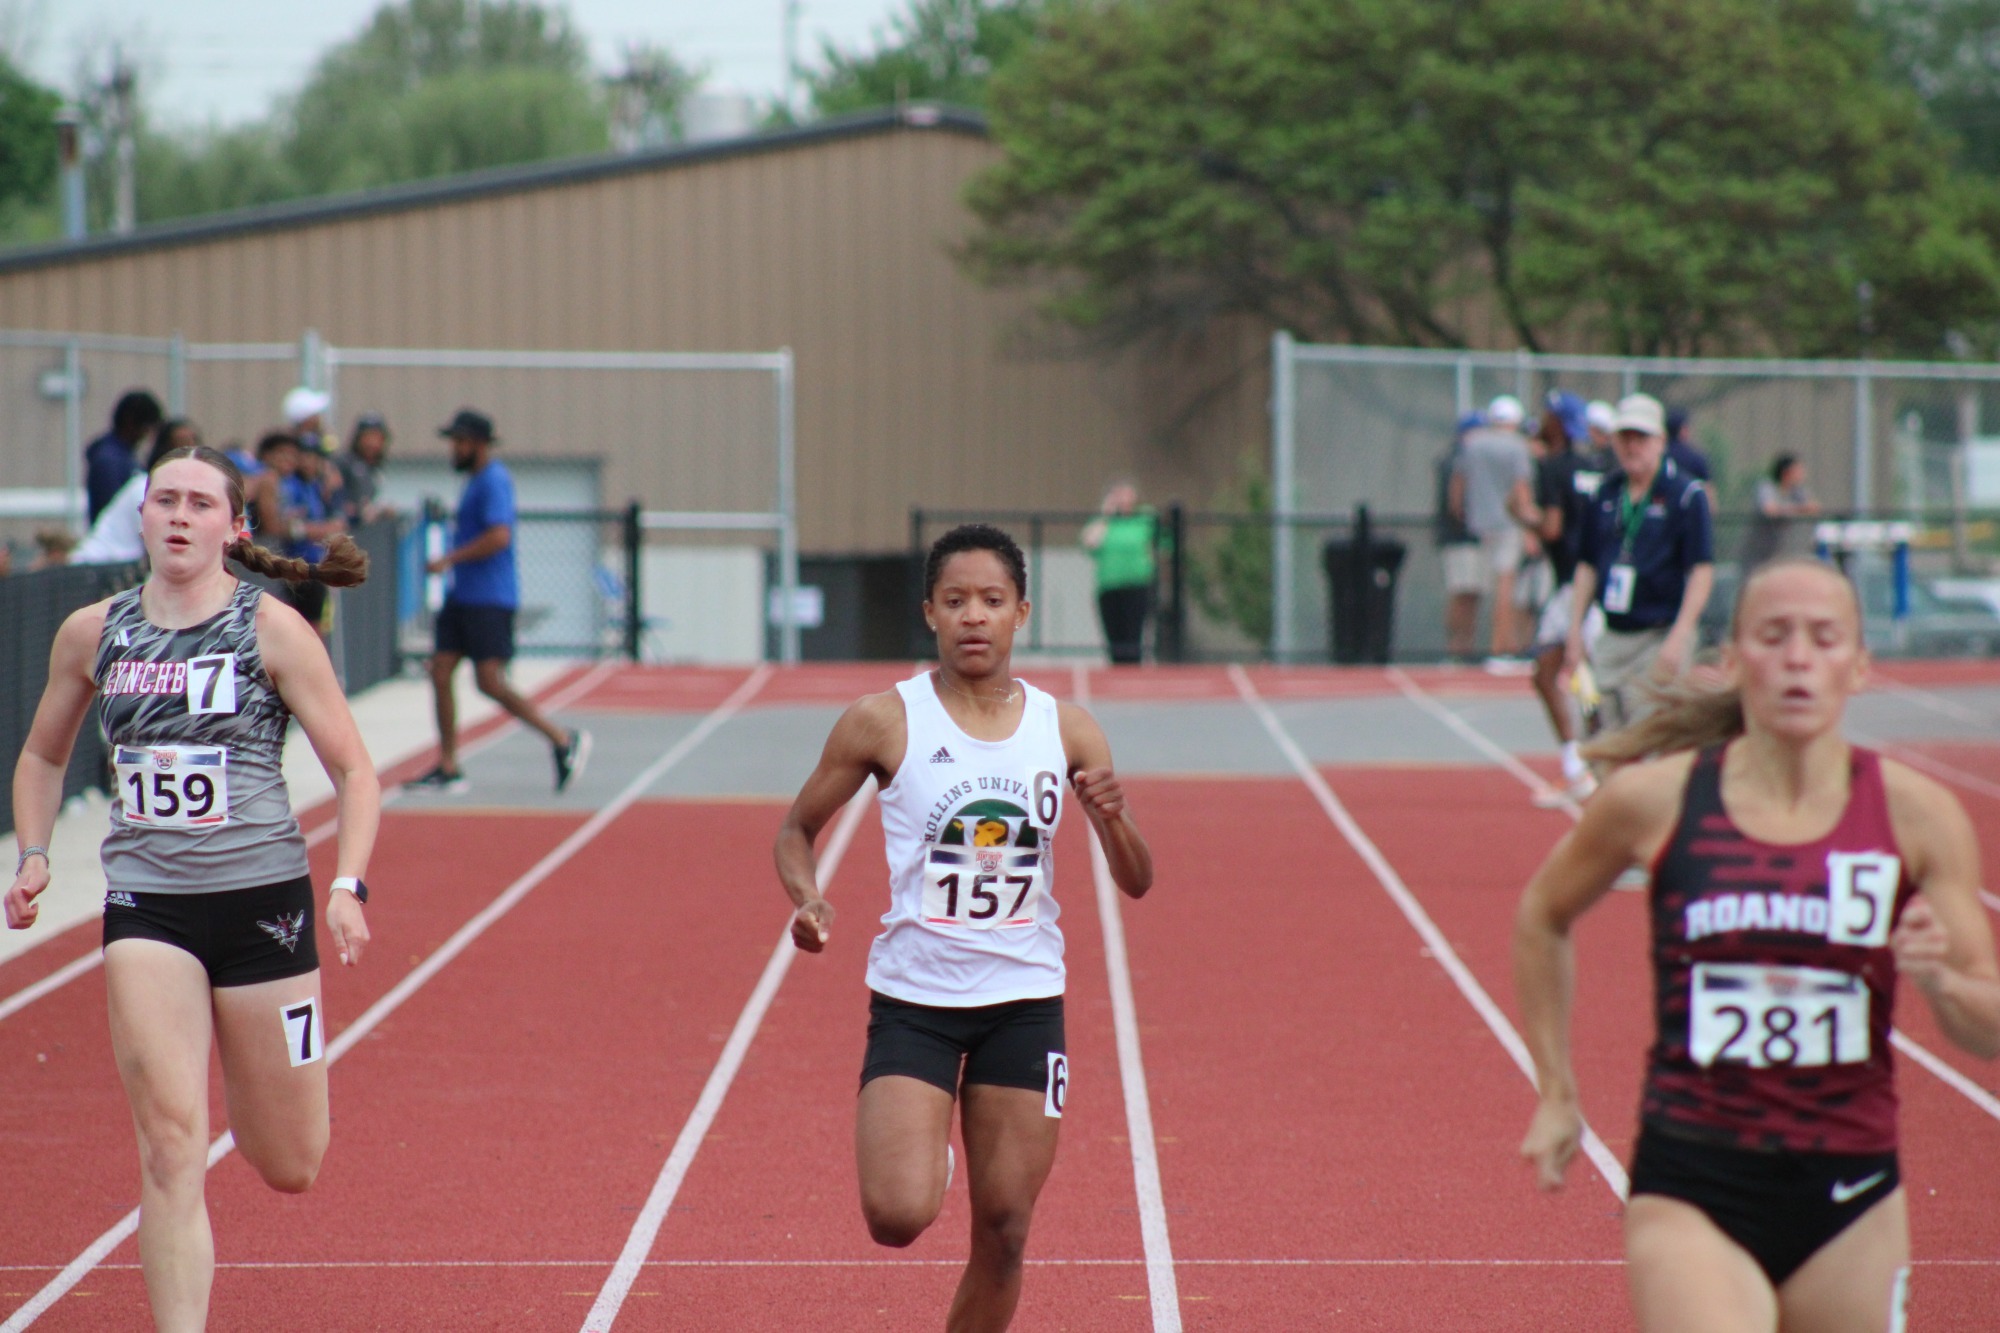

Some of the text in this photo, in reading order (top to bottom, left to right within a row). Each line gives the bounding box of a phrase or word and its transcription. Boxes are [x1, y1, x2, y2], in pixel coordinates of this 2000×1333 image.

[193, 657, 226, 709] 7
[127, 771, 215, 818] 159
[924, 779, 973, 843] HOLLINS
[1033, 770, 1059, 826] 6
[936, 872, 1033, 920] 157
[1685, 892, 1828, 942] ROANO
[1848, 864, 1880, 936] 5
[286, 1003, 313, 1061] 7
[1712, 1004, 1841, 1066] 281
[1051, 1057, 1067, 1114] 6
